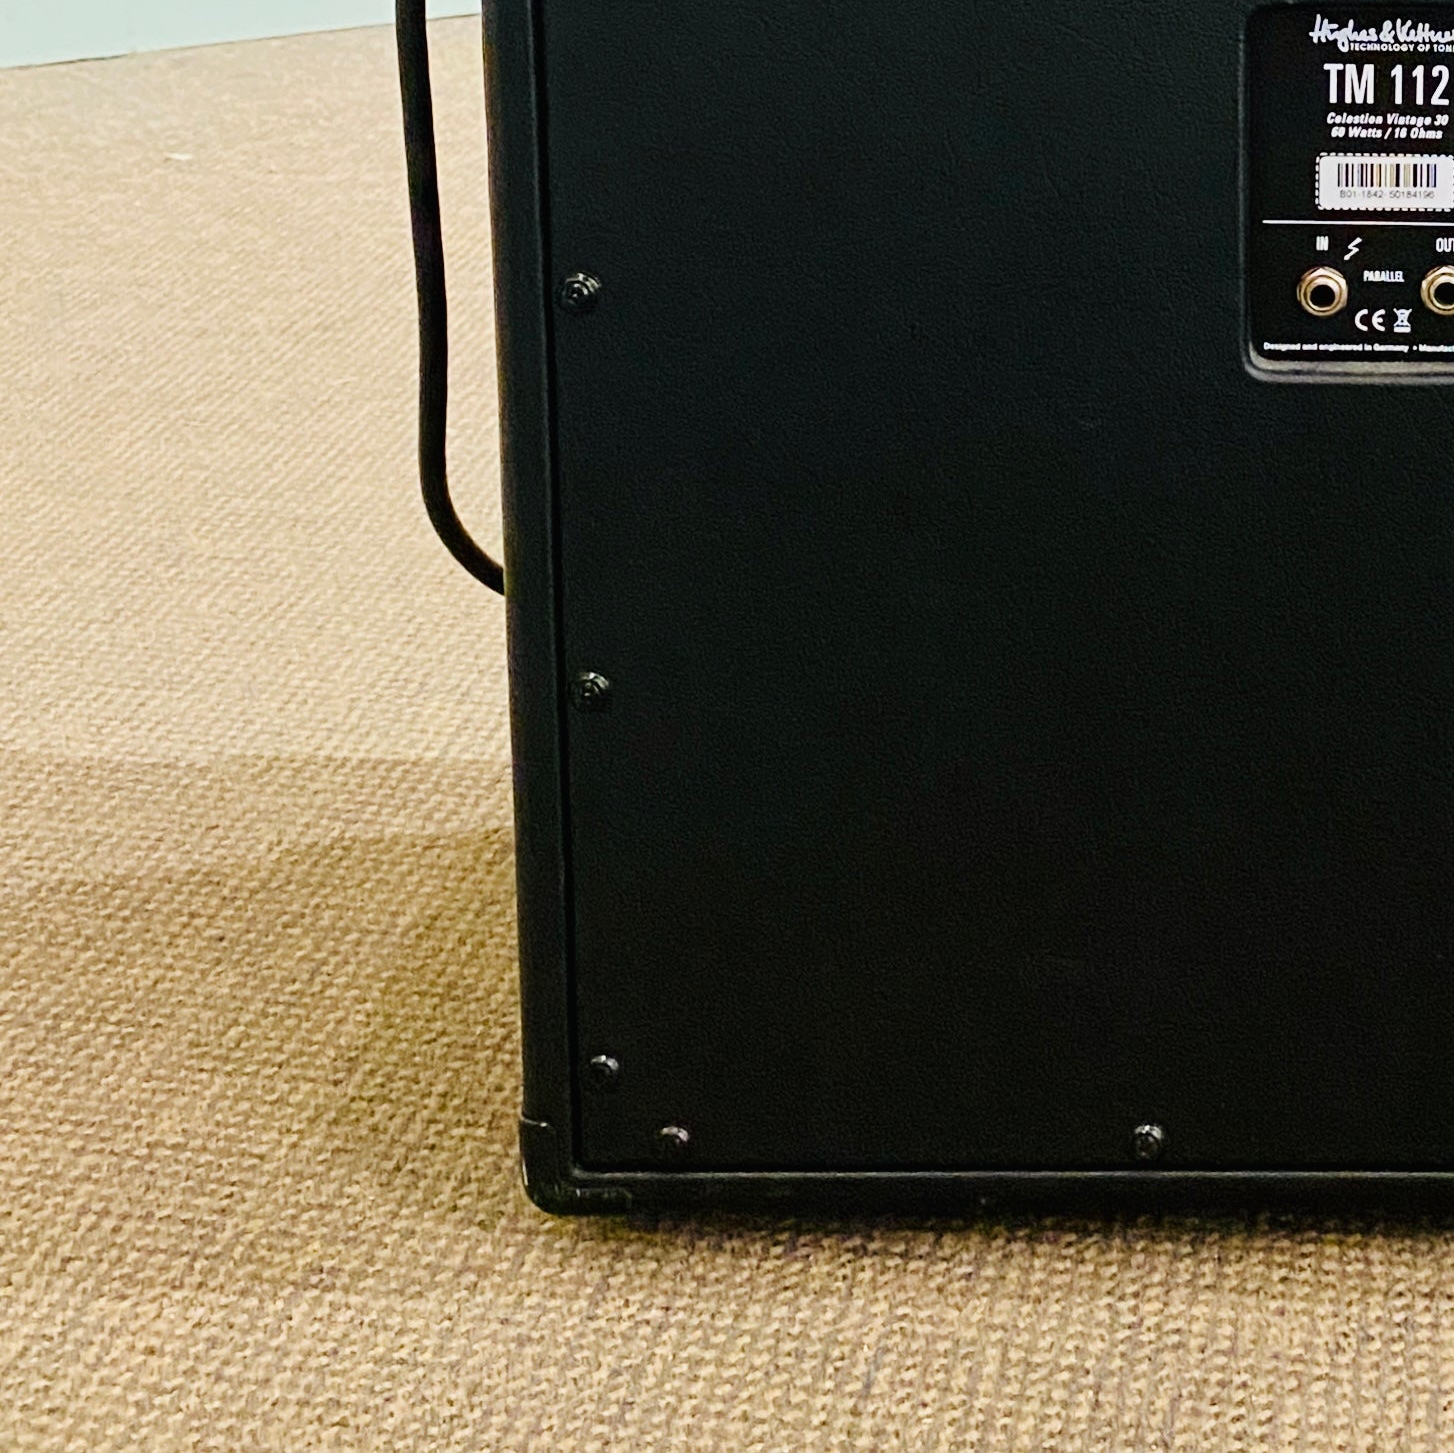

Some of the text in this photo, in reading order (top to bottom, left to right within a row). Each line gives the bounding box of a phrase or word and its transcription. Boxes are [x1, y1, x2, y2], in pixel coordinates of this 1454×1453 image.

[1309, 14, 1377, 53] Hughes
[1379, 20, 1395, 43] &
[1350, 43, 1415, 52] TECHNOLOGY
[1417, 43, 1431, 53] OF
[1323, 63, 1450, 107] TM 112
[1327, 112, 1449, 127] Celestion Vintage 30
[1331, 126, 1346, 138] 60
[1348, 127, 1383, 139] Watts
[1394, 128, 1407, 139] 16
[1410, 128, 1443, 140] Ohms
[1316, 236, 1329, 251] IN
[1363, 270, 1405, 283] PARALLEL
[1354, 308, 1386, 332] CE
[1263, 342, 1301, 352] Designed
[1302, 343, 1318, 351] and
[1318, 343, 1363, 352] engineered
[1373, 343, 1409, 353] Germany
